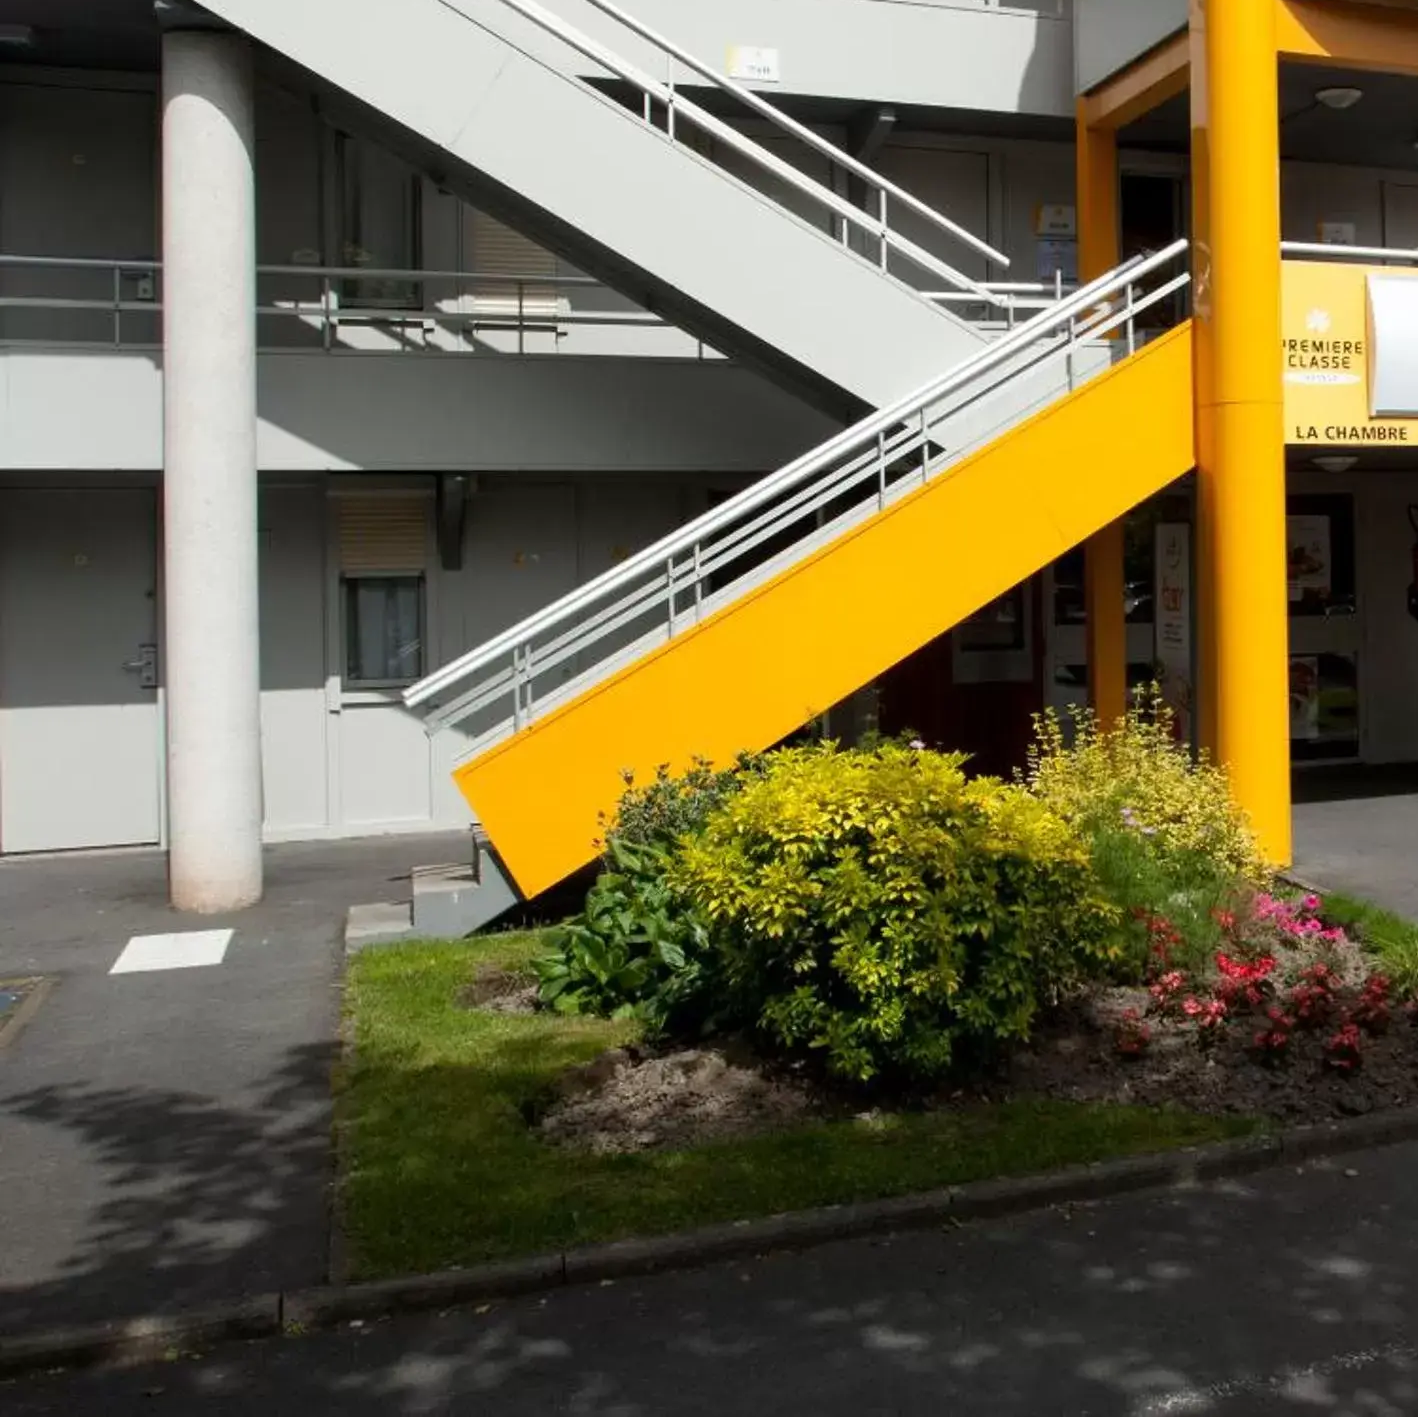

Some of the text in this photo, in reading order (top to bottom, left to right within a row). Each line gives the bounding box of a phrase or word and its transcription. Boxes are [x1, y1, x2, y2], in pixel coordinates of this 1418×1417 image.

[1288, 354, 1351, 370] CLASSE
[1295, 425, 1319, 440] LA
[1324, 425, 1408, 441] CHAMBRE
